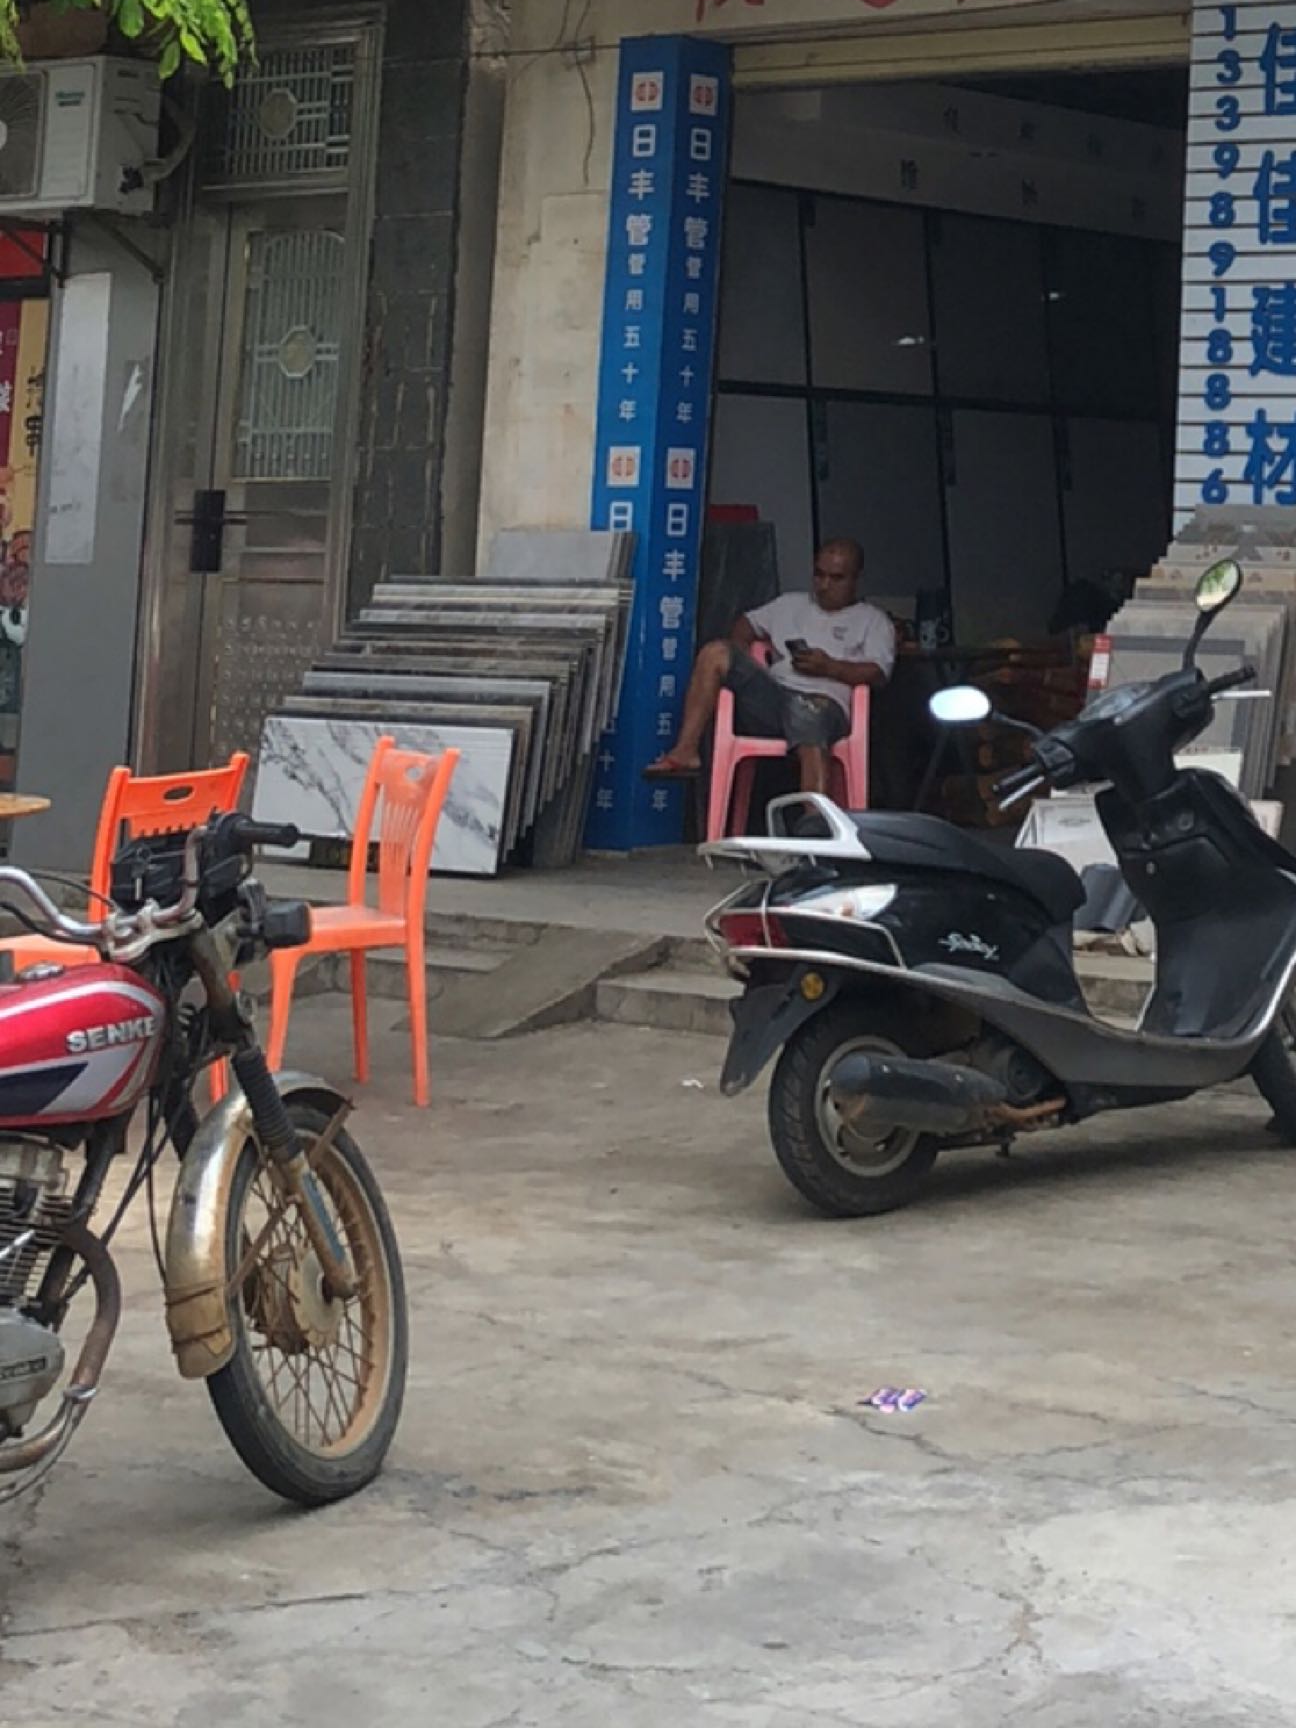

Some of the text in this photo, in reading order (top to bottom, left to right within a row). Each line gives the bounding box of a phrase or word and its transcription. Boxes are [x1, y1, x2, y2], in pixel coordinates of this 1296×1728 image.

[651, 502, 689, 812] 日丰管管用五年
